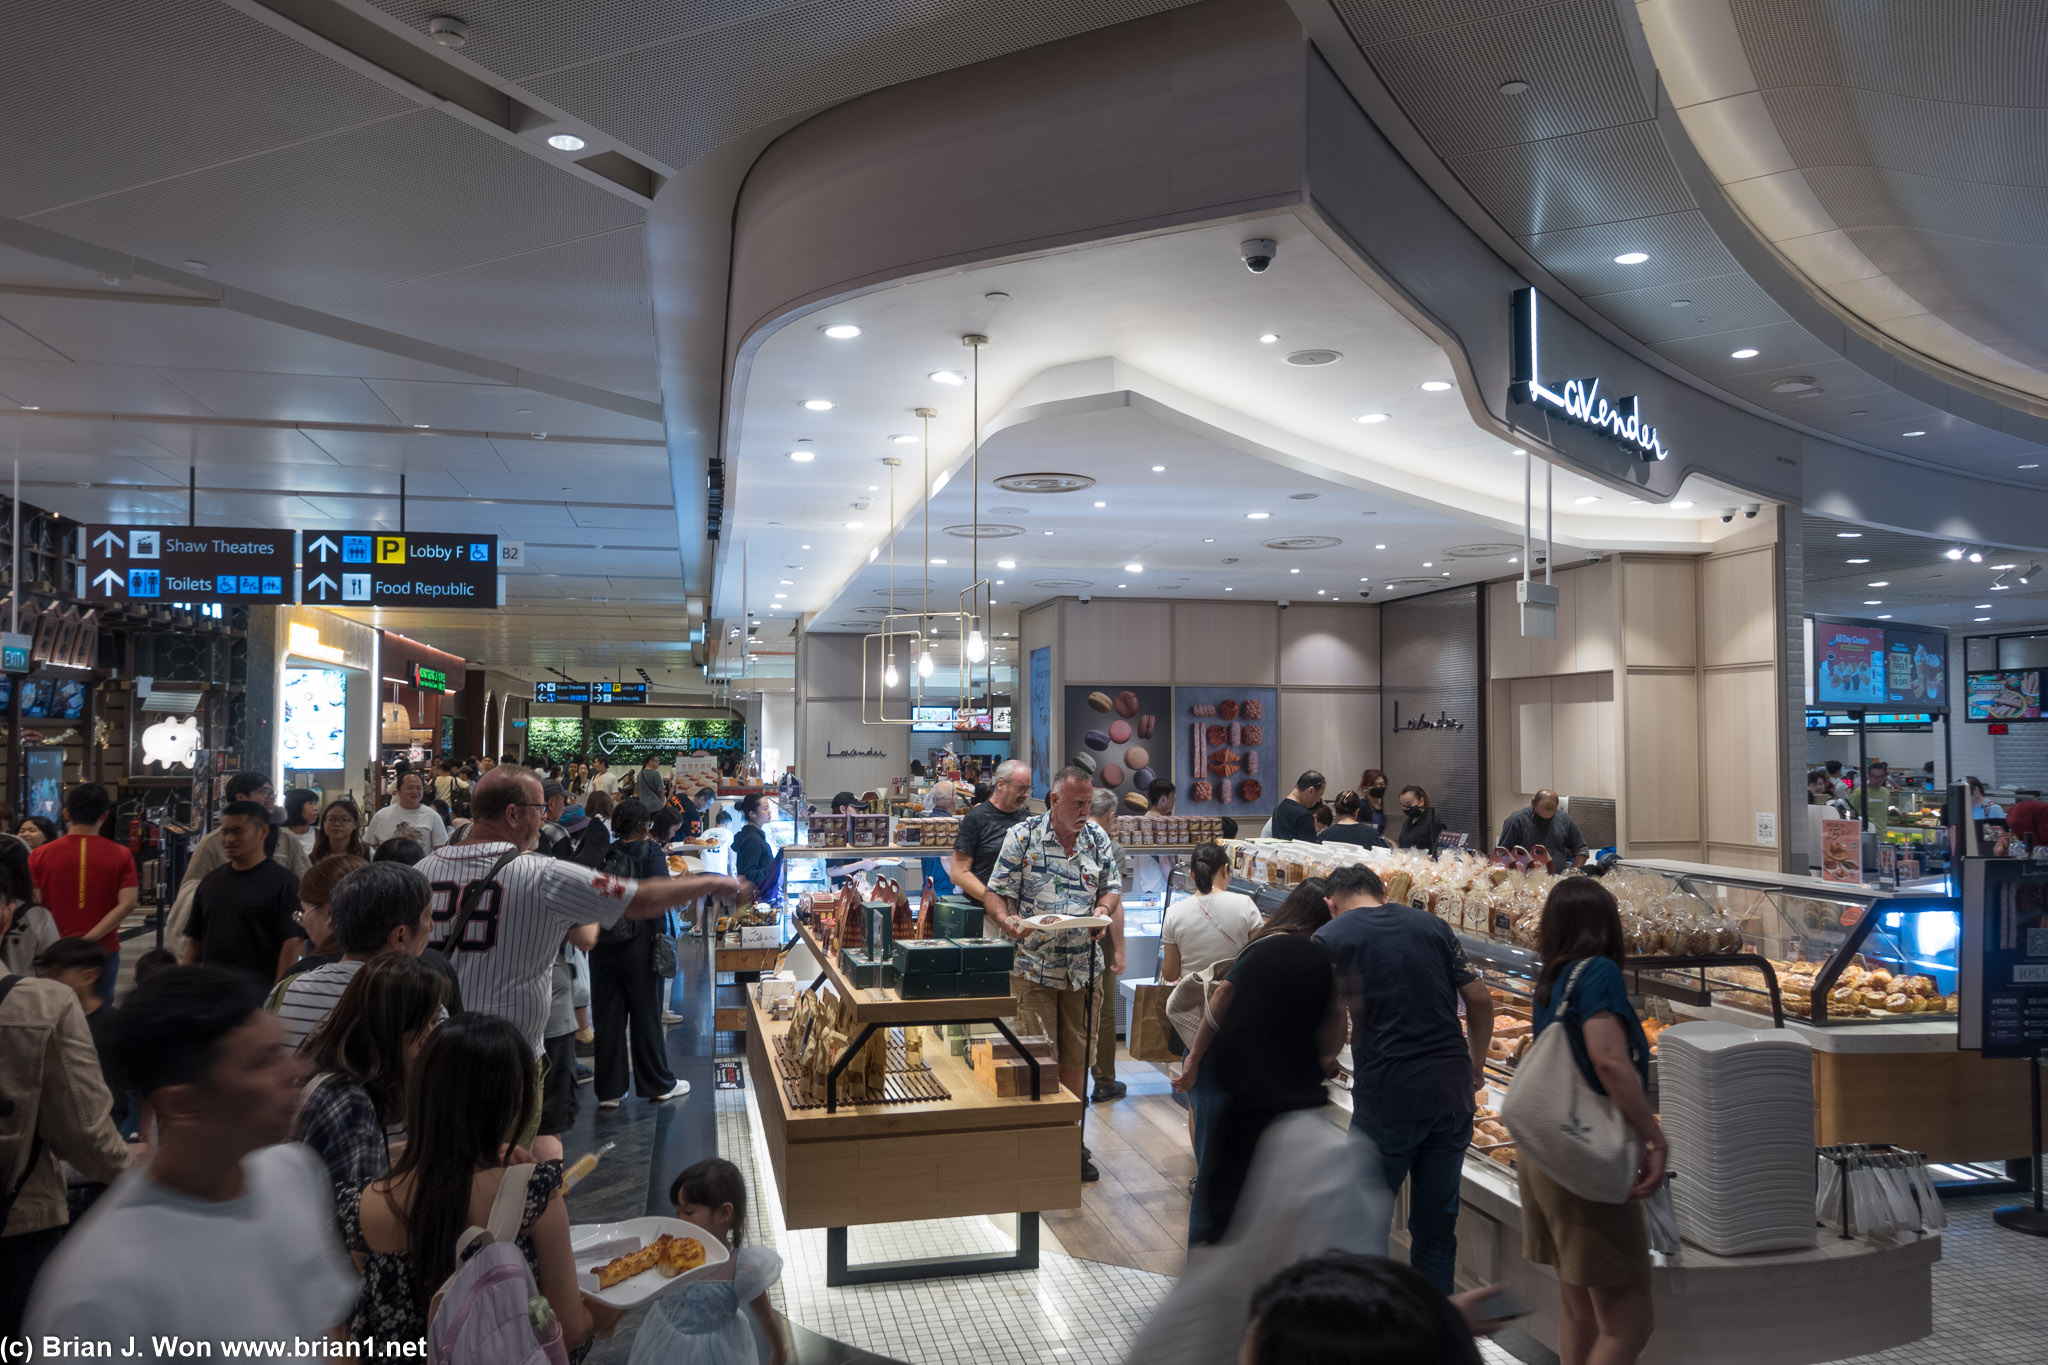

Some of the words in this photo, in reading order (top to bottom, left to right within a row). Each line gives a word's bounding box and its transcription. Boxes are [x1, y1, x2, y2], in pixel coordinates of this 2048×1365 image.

[165, 538, 207, 552] Shaw
[211, 540, 275, 555] Theatres
[382, 540, 400, 561] P
[410, 545, 452, 562] Lobby
[456, 546, 464, 558] F
[502, 547, 519, 560] B2
[165, 577, 212, 591] Toilets
[375, 581, 411, 595] Food
[415, 582, 475, 598] Republic
[5, 650, 21, 667] EXIT
[690, 737, 743, 750] IMAX
[827, 741, 887, 759] Lavender
[428, 879, 504, 953] 28
